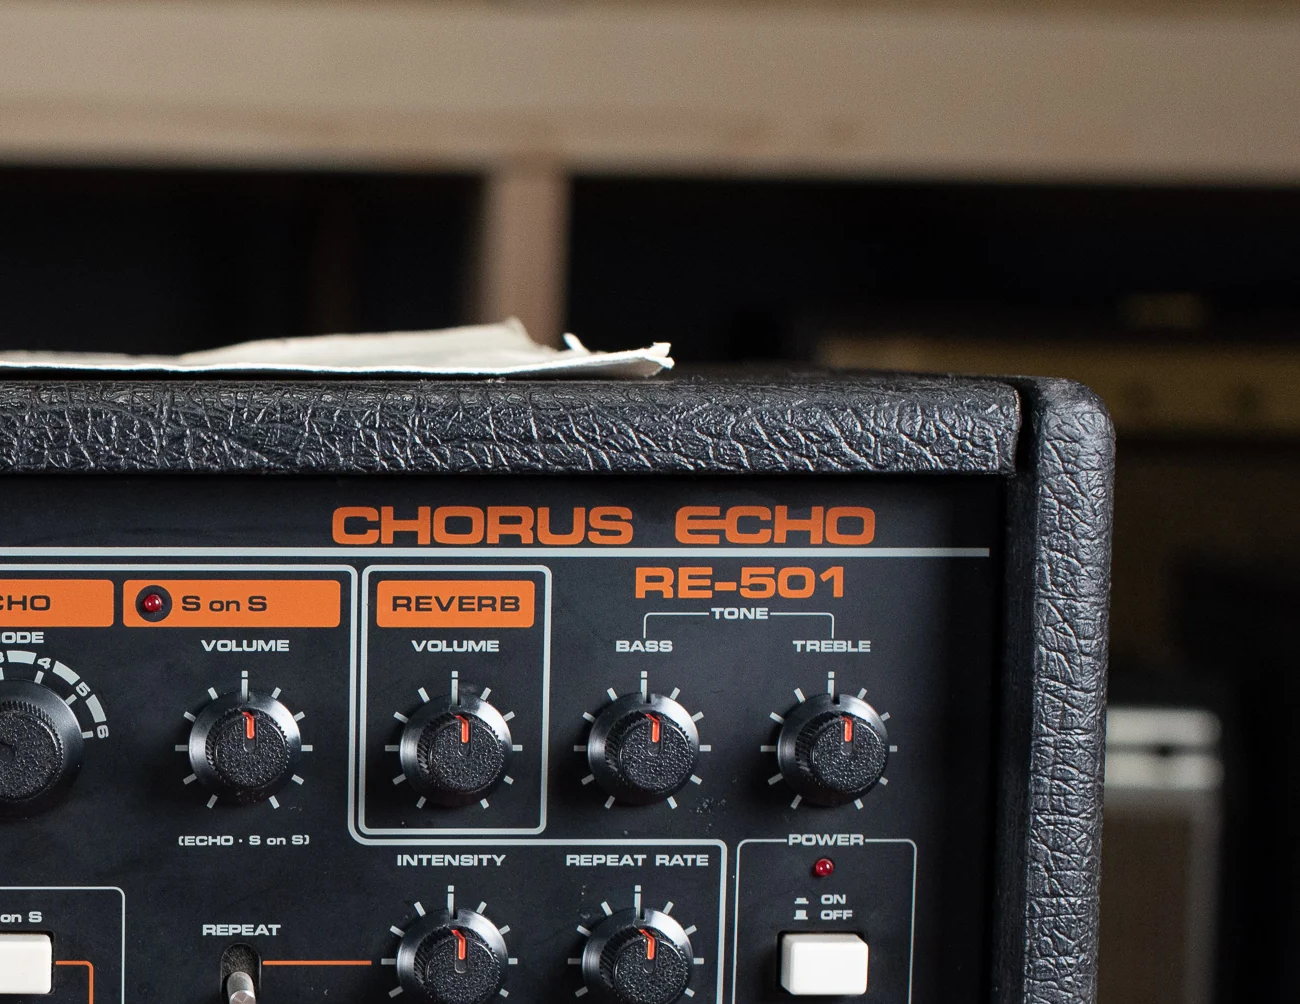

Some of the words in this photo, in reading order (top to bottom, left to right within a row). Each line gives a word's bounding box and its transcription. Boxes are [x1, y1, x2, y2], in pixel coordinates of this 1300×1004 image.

[332, 507, 633, 545] CHORUS
[675, 506, 875, 545] ECHO
[635, 566, 844, 599] RE-501
[182, 596, 200, 611] S
[209, 600, 240, 612] on
[248, 596, 267, 611] S
[393, 596, 520, 611] REVERB
[711, 608, 768, 620] TONE
[201, 640, 289, 651] VOLUME
[412, 640, 499, 652] VOLUME
[616, 640, 673, 652] BASS
[792, 640, 871, 652] TREBLE
[37, 657, 52, 670] 4
[75, 681, 91, 697] 5
[96, 725, 110, 739] 6
[249, 835, 261, 845] S
[789, 834, 864, 846] POWER
[397, 855, 506, 866] INTENSITY
[566, 855, 647, 866] REPEAT
[656, 855, 709, 866] RATE
[821, 894, 846, 904] ON
[0, 914, 22, 922] on
[29, 911, 42, 922] S
[821, 910, 852, 920] OFF
[203, 924, 281, 935] REPEAT
